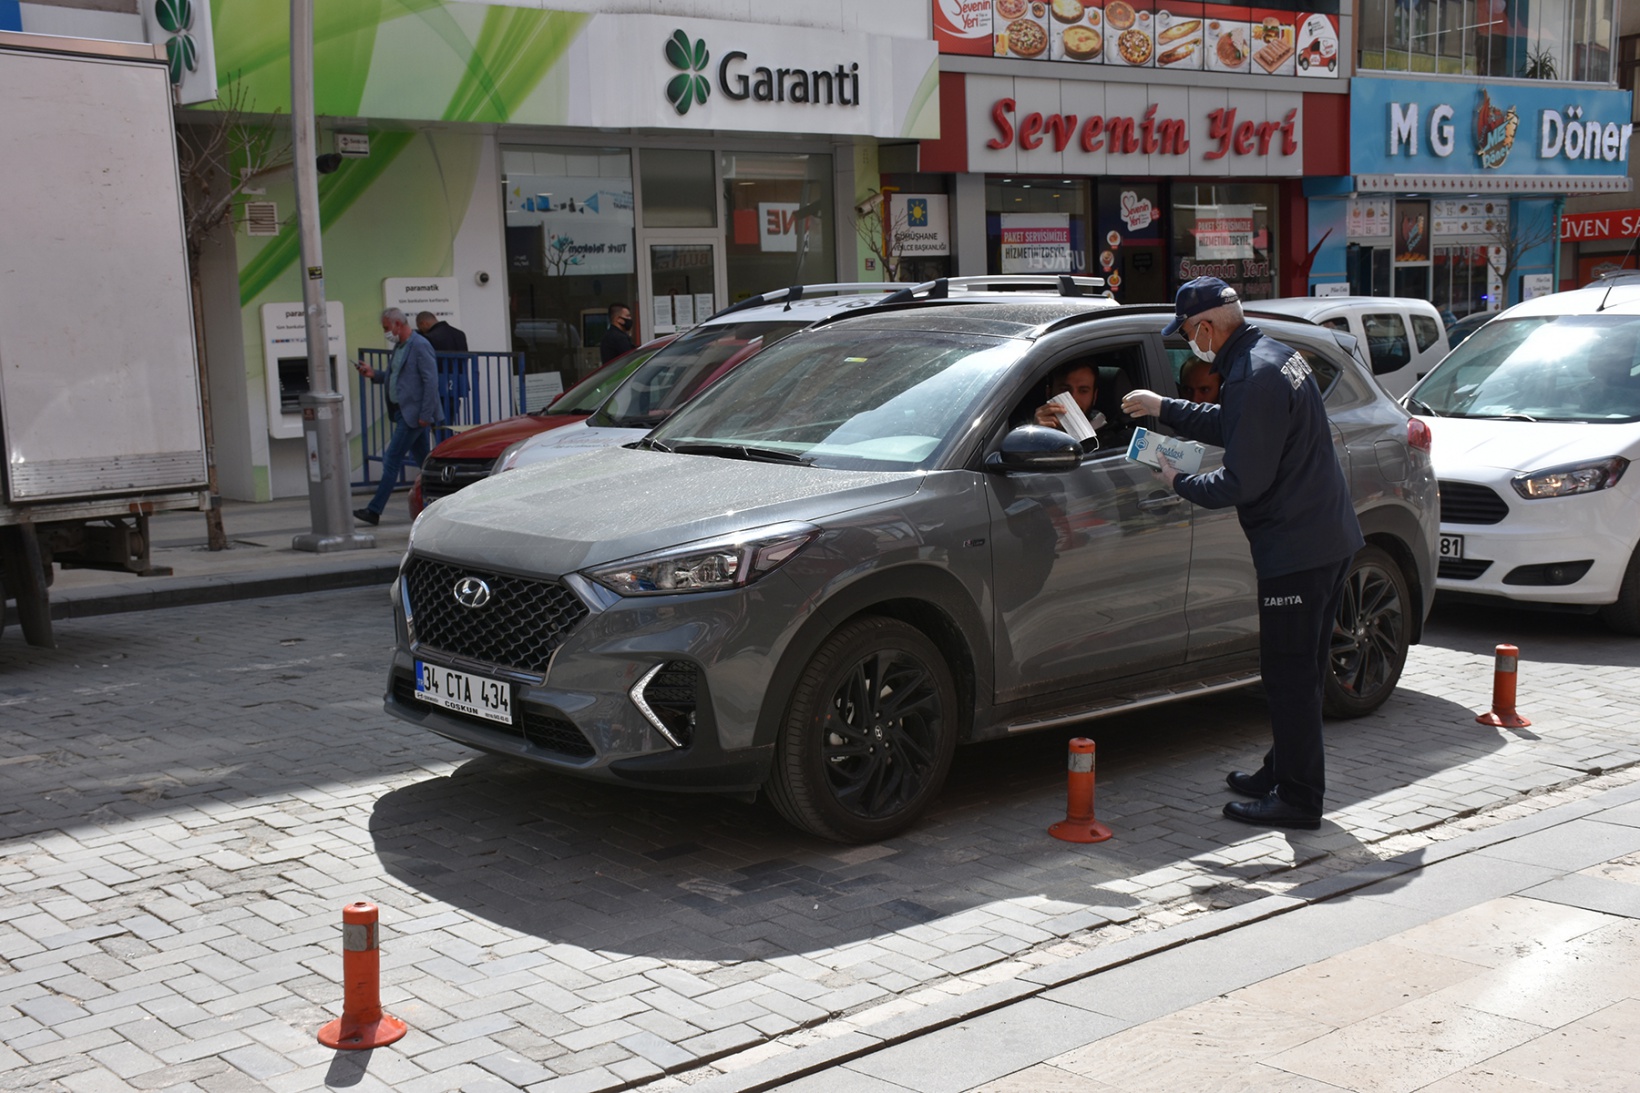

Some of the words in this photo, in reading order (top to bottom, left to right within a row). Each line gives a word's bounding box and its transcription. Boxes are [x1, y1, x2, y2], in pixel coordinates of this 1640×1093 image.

[962, 13, 979, 29] Yeri
[717, 50, 859, 106] Garanti
[987, 97, 1190, 156] Sevenin
[1203, 107, 1299, 160] Yeri
[1390, 102, 1418, 156] M
[1430, 103, 1455, 157] G
[1541, 104, 1633, 162] Döner
[1198, 221, 1215, 231] PAKET
[1553, 217, 1610, 239] ÜVEN
[1004, 231, 1024, 242] PAKET
[1026, 229, 1067, 242] SERVİSİMİZLE
[1179, 259, 1237, 279] Sevenin
[1243, 260, 1270, 278] Yeri
[405, 284, 439, 293] paramatik
[1156, 443, 1184, 459] ProMask
[1440, 538, 1459, 556] 81
[1264, 595, 1302, 607] ZABITA
[423, 665, 439, 694] 34
[446, 672, 472, 703] CTA
[481, 680, 508, 712] 434
